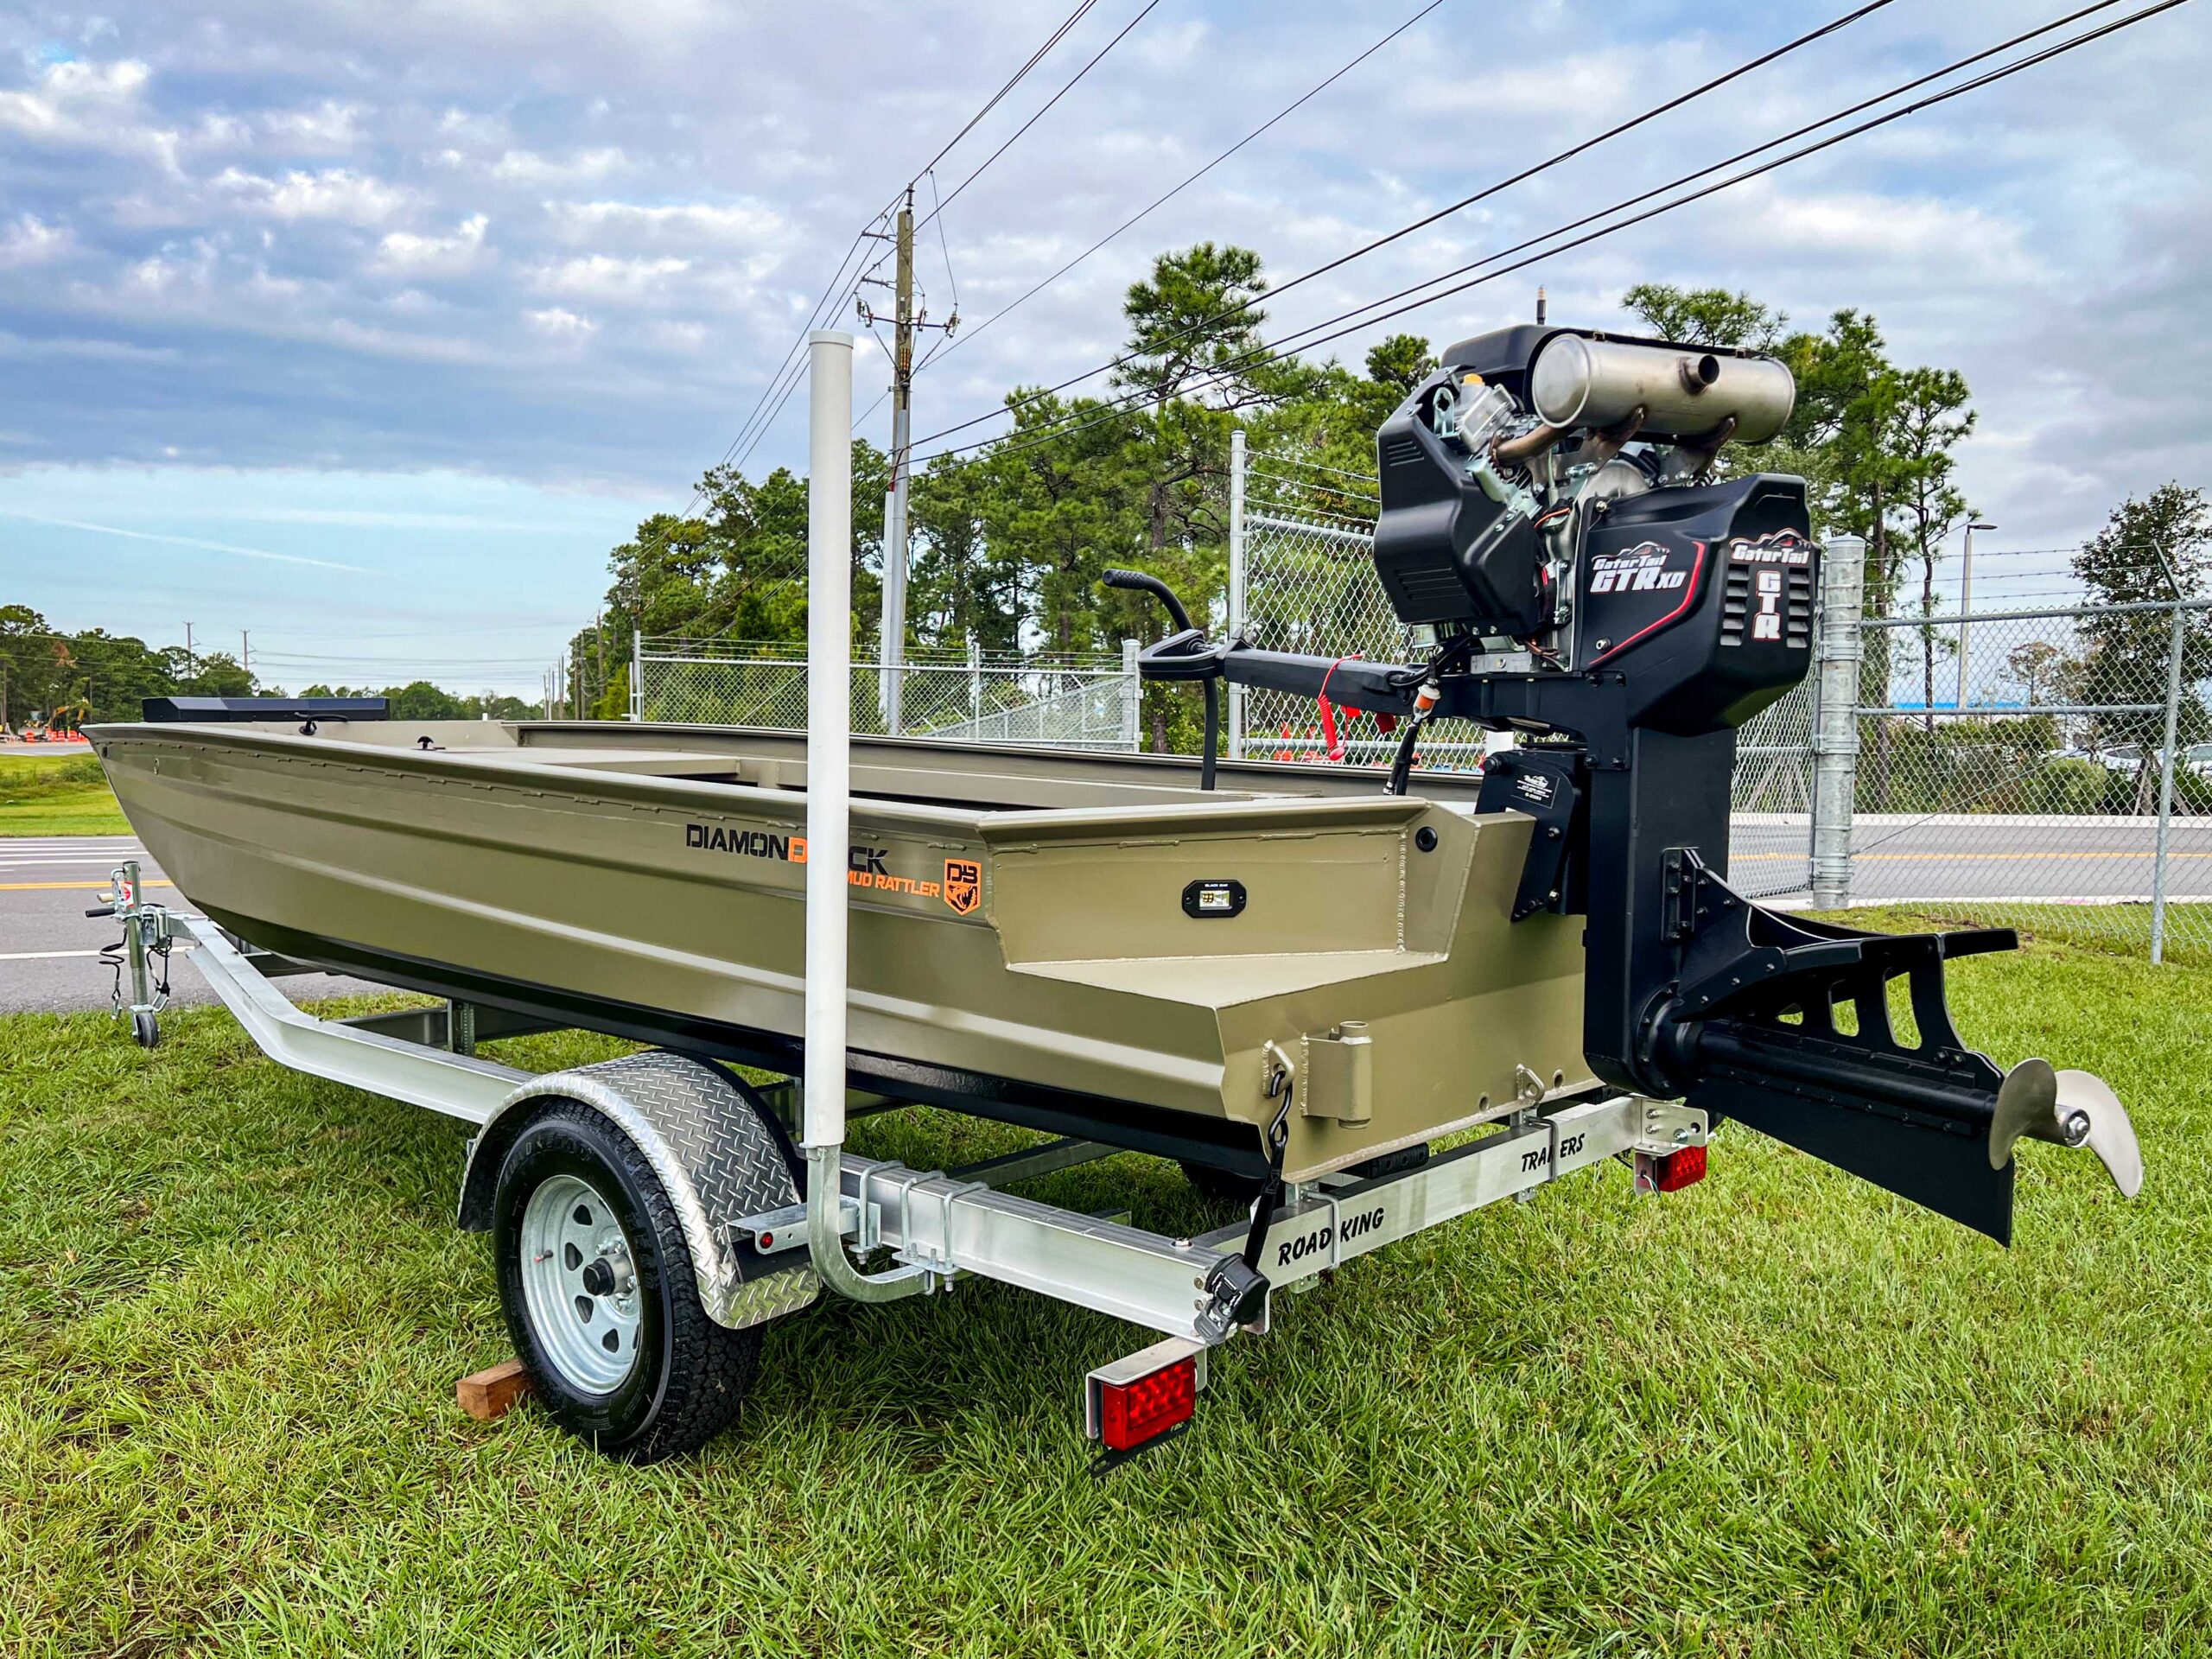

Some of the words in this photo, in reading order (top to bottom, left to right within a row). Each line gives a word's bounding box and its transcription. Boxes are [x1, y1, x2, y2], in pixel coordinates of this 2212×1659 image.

[1592, 555, 1668, 570] GatorTail
[1732, 544, 1809, 564] GatorTail
[1753, 571, 1782, 639] GTR
[686, 823, 888, 875] DIAMONDCK
[874, 874, 940, 897] RATTLER
[1522, 1133, 1585, 1173] TRAIERS
[1277, 1227, 1332, 1266] ROAD
[1340, 1207, 1384, 1243] KING
